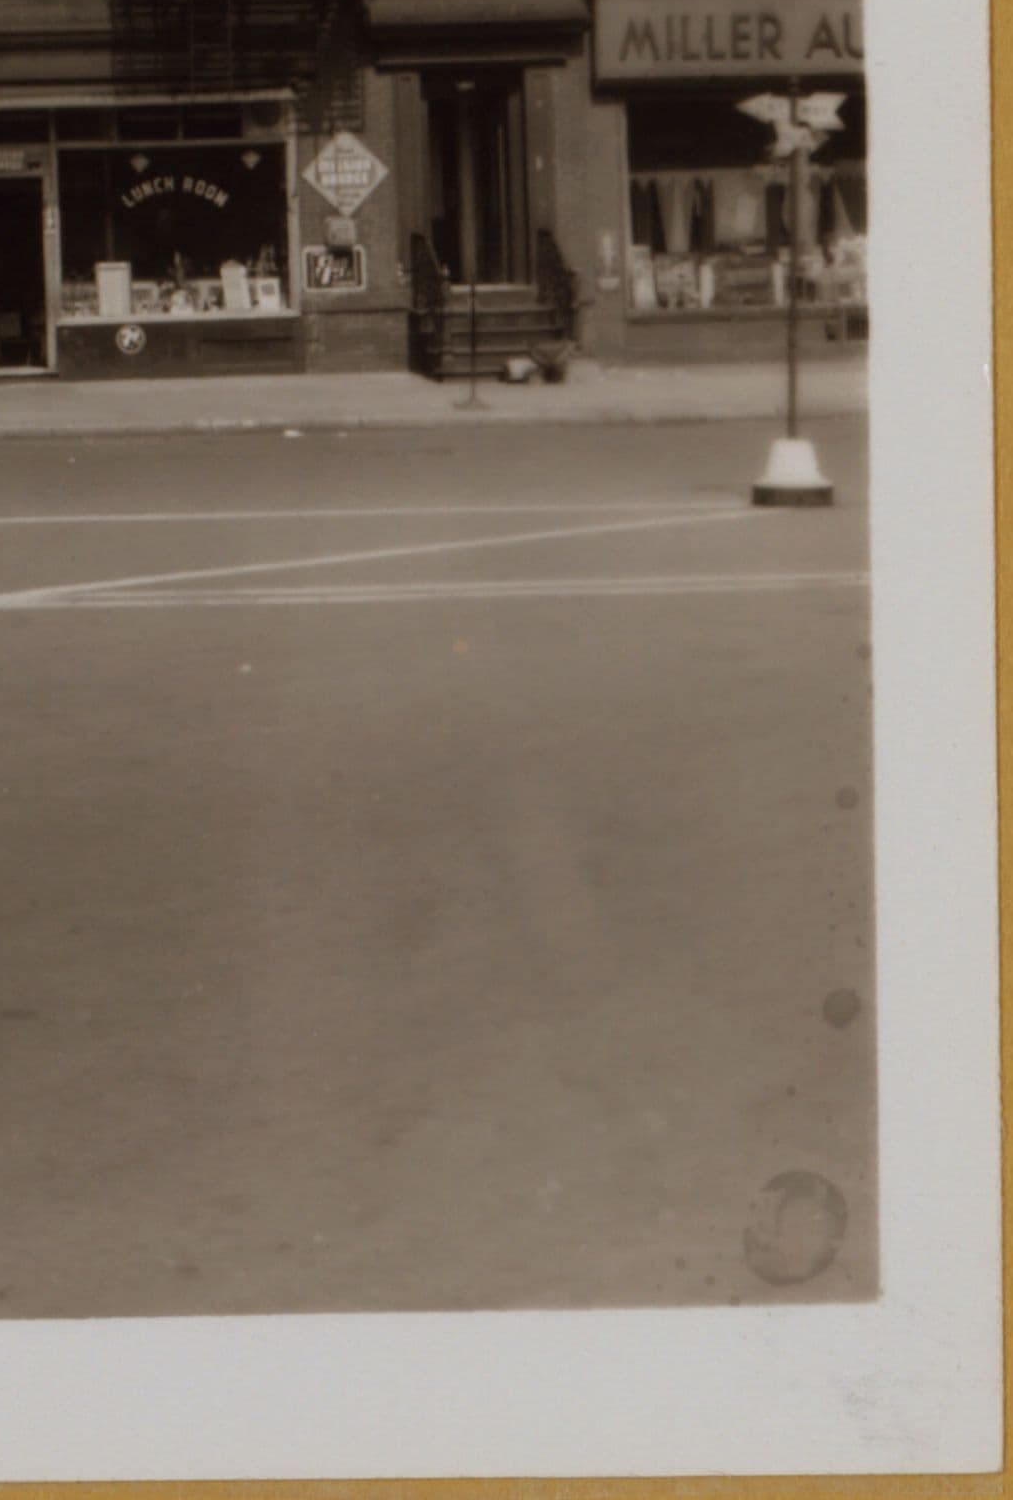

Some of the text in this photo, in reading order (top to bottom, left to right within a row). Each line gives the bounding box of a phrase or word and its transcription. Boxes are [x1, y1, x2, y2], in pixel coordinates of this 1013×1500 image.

[619, 12, 783, 62] MILLER
[121, 175, 230, 208] LUNCH ROOM
